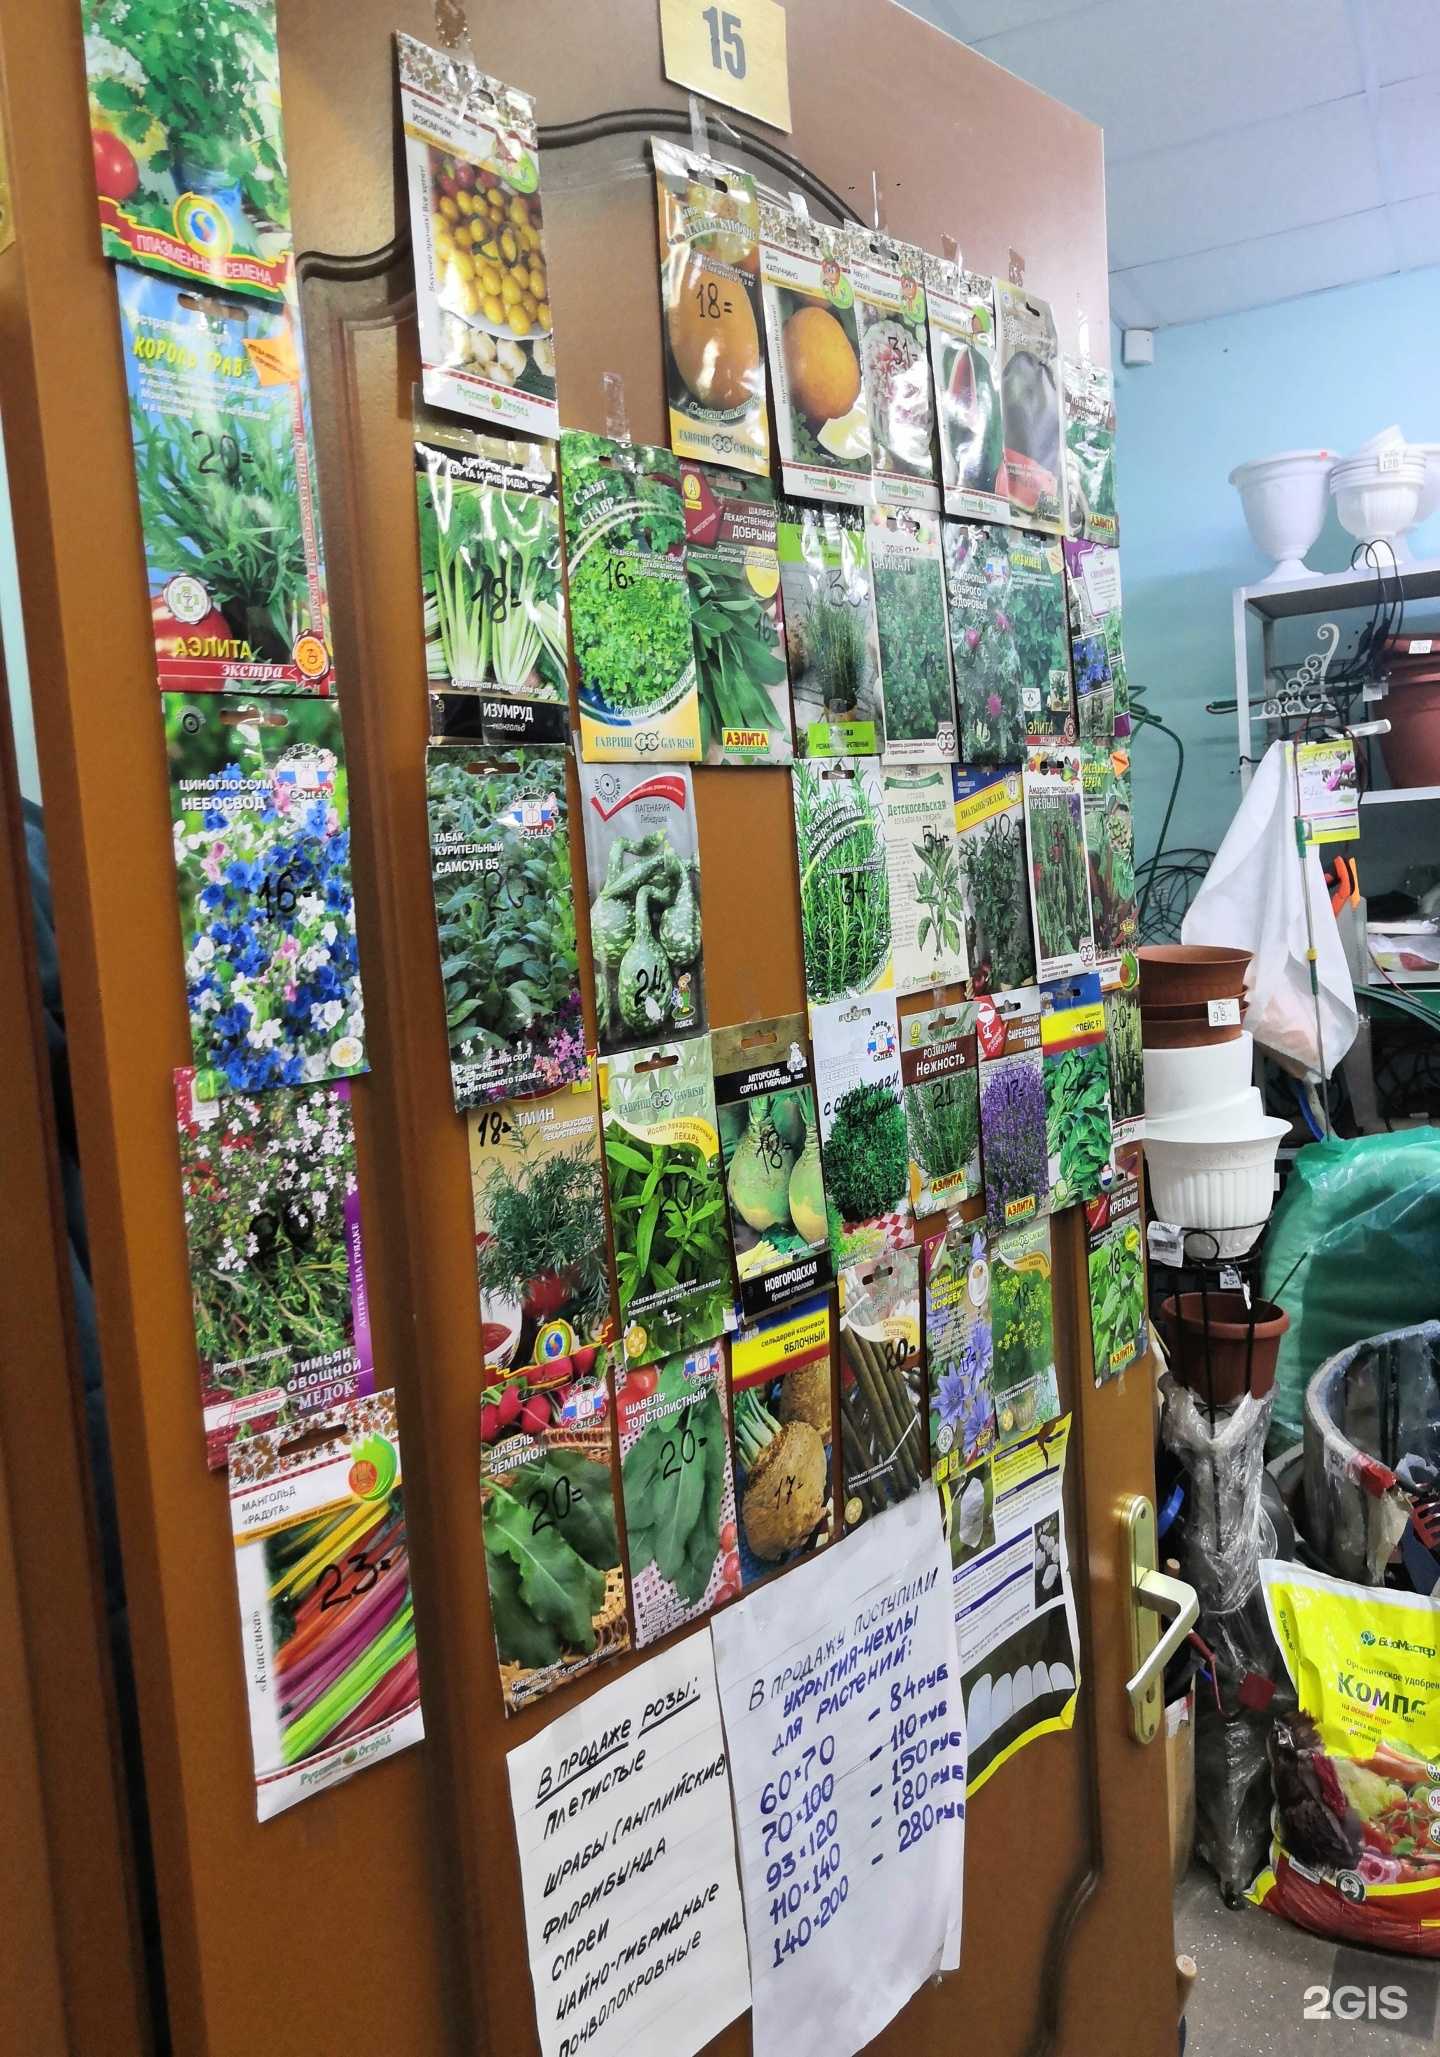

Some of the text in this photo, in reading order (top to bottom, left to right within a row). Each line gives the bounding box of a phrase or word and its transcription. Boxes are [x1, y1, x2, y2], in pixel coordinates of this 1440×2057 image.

[702, 6, 746, 80] 15
[224, 255, 273, 285] СЕМЕНА
[732, 525, 777, 543] ДОБРЫНЯ
[174, 637, 252, 659] АЭЛИТА
[221, 664, 284, 680] экстра
[482, 702, 534, 723] ИЗУМРУД
[726, 732, 768, 746] АЭЛИТА
[179, 778, 274, 792] ЦИНОГЛОССУМ
[181, 797, 267, 811] НЕБОСВОД
[887, 800, 947, 817] Детскосельская
[434, 831, 465, 844] ТАБАК
[435, 842, 504, 857] КУРИТЕЛЬНЫЙ
[435, 857, 499, 875] САМСУН 85
[923, 1041, 958, 1058] РОЗМАРИН
[740, 1075, 792, 1095] СОРТА И ГИБРИДЫ
[748, 1068, 781, 1083] АВТОРСКИЕ
[516, 1107, 555, 1128] ТМИН
[932, 1171, 963, 1194] АЭЛИТА
[1007, 1198, 1035, 1217] АЭЛИТА
[1109, 1190, 1139, 1217] КРЕПЫШ
[764, 1261, 818, 1293] НОВГОРОДСКАЯ
[354, 1282, 367, 1329] АПТЕКА
[783, 1329, 826, 1355] ЯБЛОЧНЫЙ
[1111, 1344, 1134, 1366] АЭЛИТА
[291, 1348, 352, 1376] ТИМЬЯН
[286, 1358, 362, 1393] ОВОЩНОЙ
[625, 1391, 667, 1416] ЩАВЕЛЬ
[625, 1386, 708, 1430] ТОЛСТОЛИСТНЫЙ
[490, 1433, 535, 1461] ЩАВЕЛЬ
[490, 1446, 548, 1478] ЧЕМПИОН
[241, 1486, 297, 1513] МАНГОЛЬД
[527, 1475, 583, 1536] 20=
[748, 1678, 766, 1712] В
[853, 1566, 939, 1637] ПОСТУПИЛИ
[783, 1604, 920, 1719] УКРЫТИЯ-ЧЕХЛЫ
[537, 1677, 700, 1800] В ПРОДАЖЕ РОЗЫ:
[771, 1715, 804, 1758] ДЛЯ
[543, 1749, 647, 1841] ПЛЕТИСТЫЕ
[543, 1831, 609, 1898] ШРАБЫ
[558, 1929, 703, 2057] ПОЧВОПОКРОВНЫЕ
